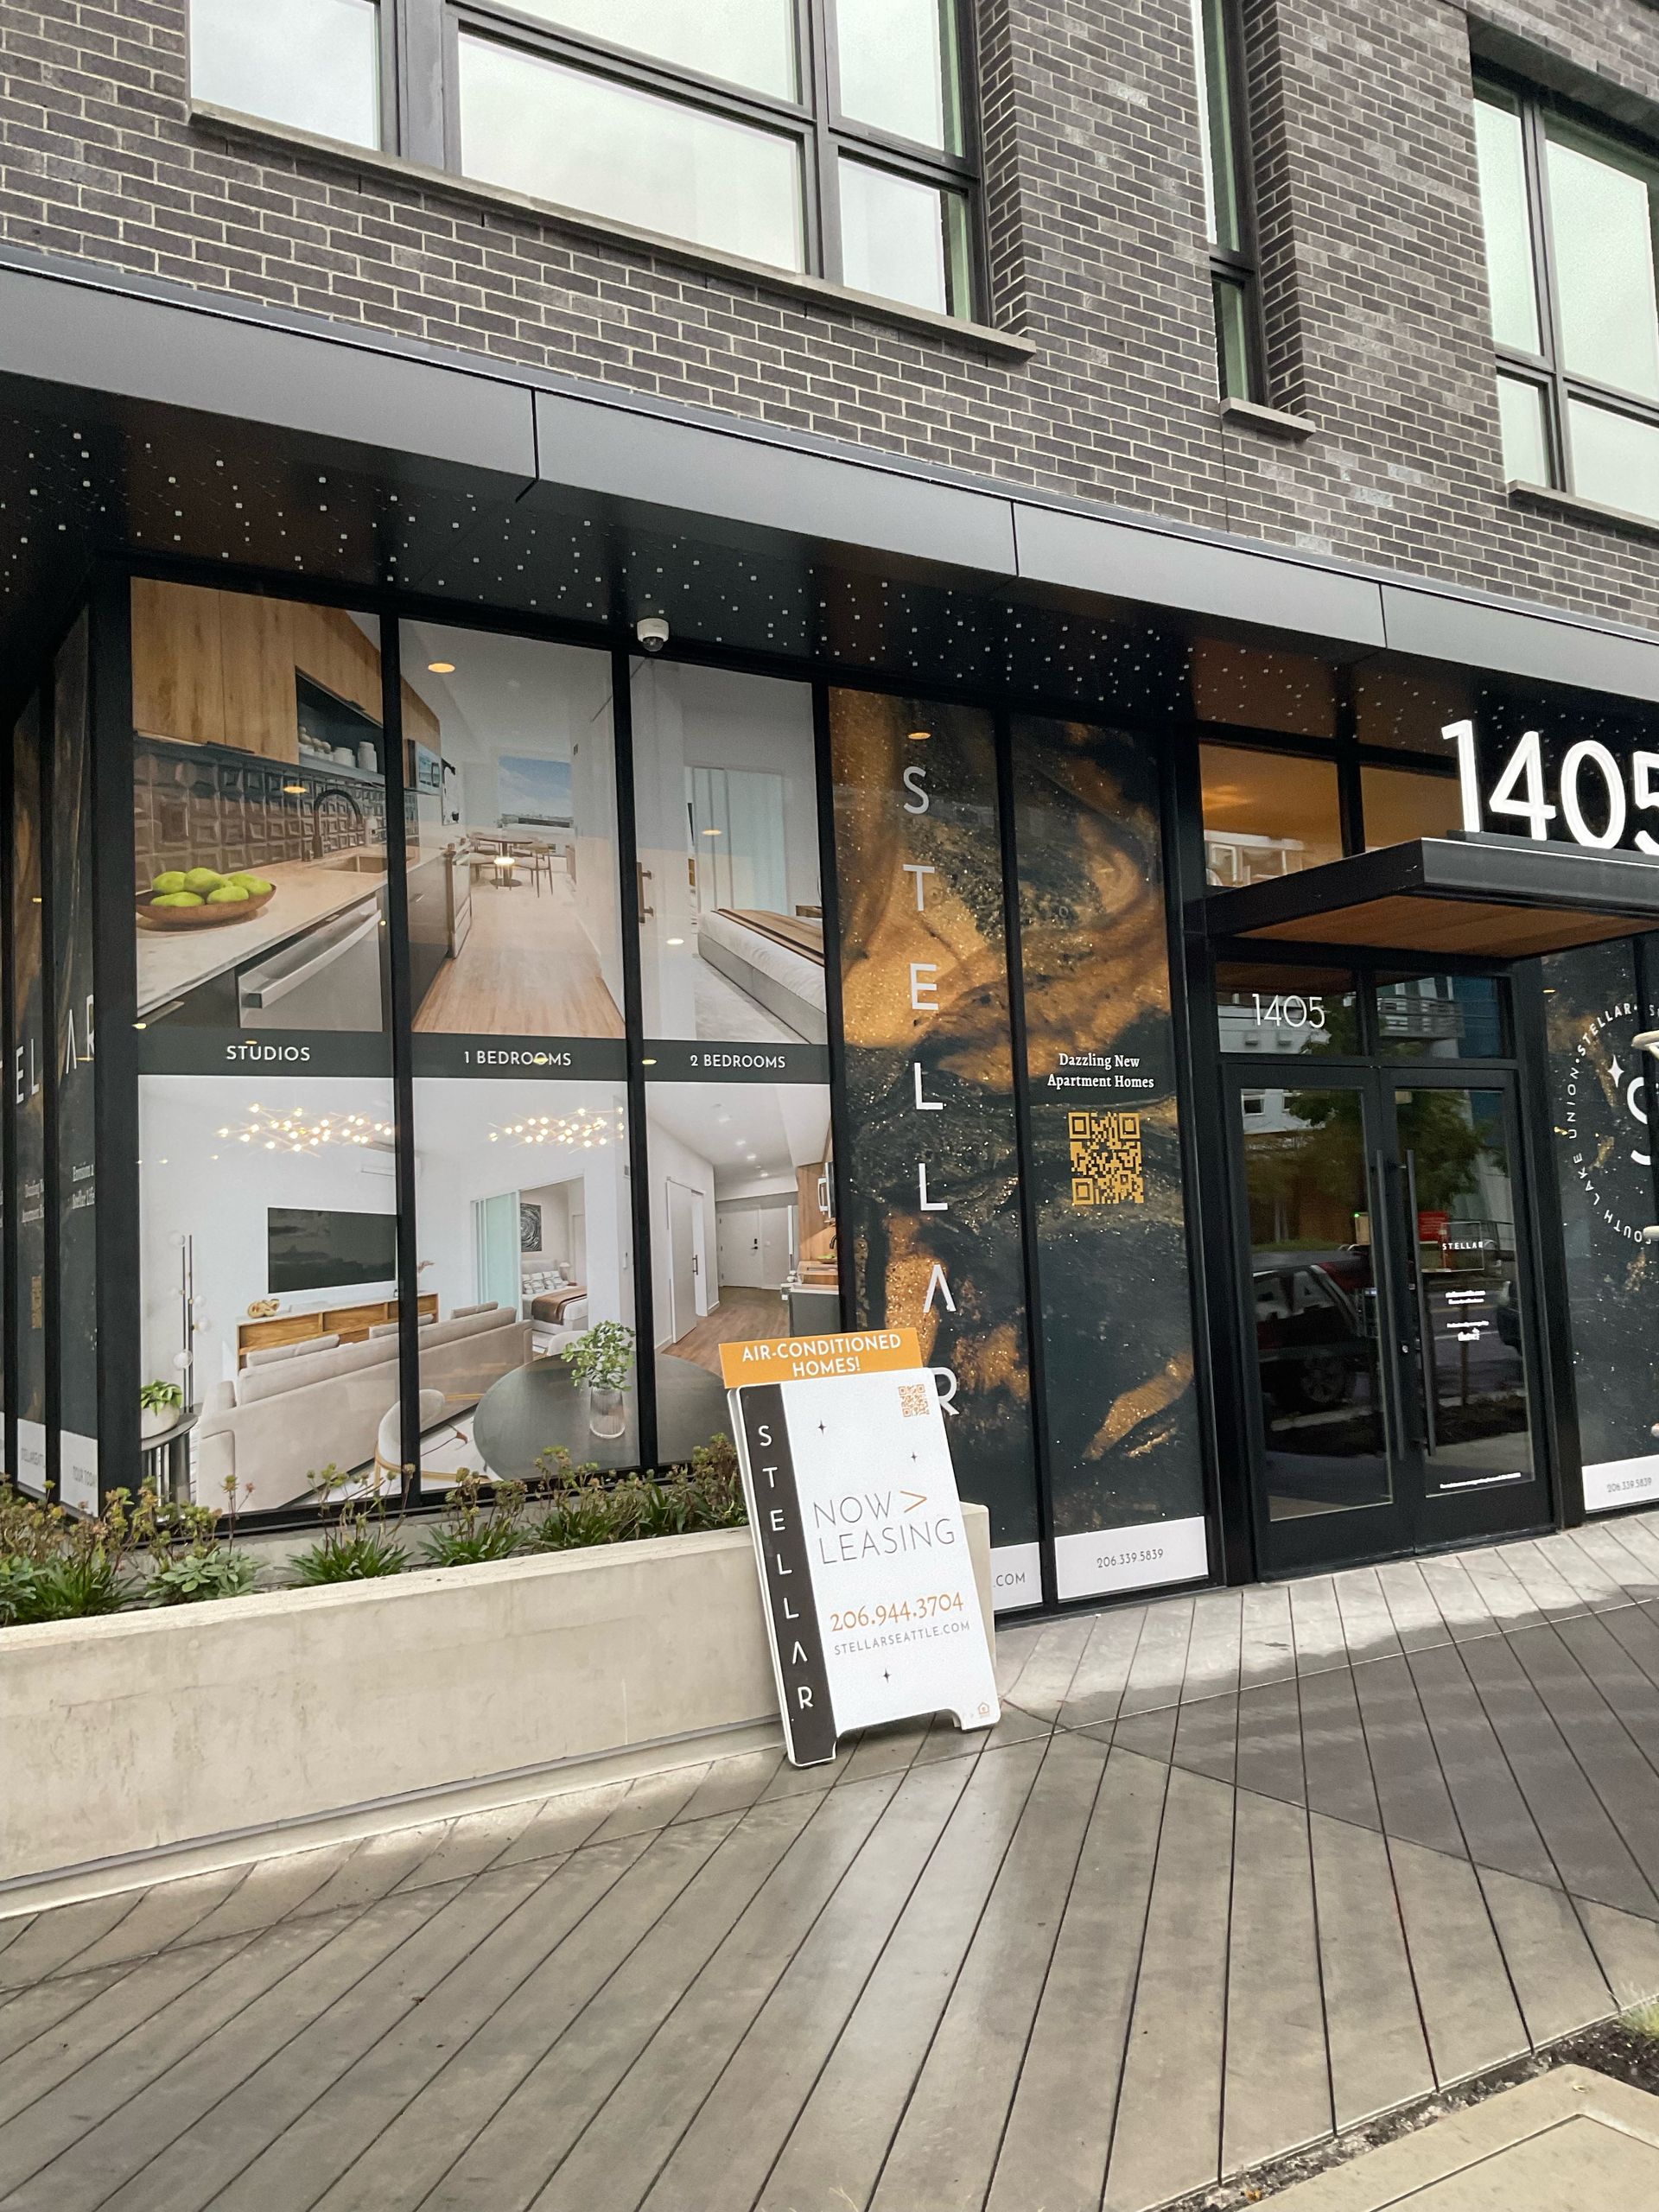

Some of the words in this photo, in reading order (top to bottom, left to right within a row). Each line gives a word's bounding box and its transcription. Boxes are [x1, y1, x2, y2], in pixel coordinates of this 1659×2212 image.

[1252, 994, 1325, 1028] 1405
[1577, 1002, 1631, 1057] STELLAR
[226, 1045, 311, 1062] STUDIOS
[464, 1050, 470, 1064] 1
[476, 1050, 572, 1066] BEDROOMS
[690, 1054, 699, 1067] 2
[703, 1054, 786, 1069] BEDROOMS
[1058, 1052, 1112, 1071] Dazzling
[1114, 1054, 1141, 1068] New
[903, 766, 960, 1415] STELLAR
[1047, 1073, 1112, 1090] Apartment
[1114, 1075, 1154, 1088] Homes
[1566, 1066, 1580, 1139] UNION
[1573, 1152, 1600, 1206] LAKE
[1442, 1241, 1484, 1250] STELLAR
[741, 1333, 901, 1363] AIR-CONDITIONED
[791, 1356, 861, 1377] HOMES!
[813, 1491, 892, 1529] NOW
[819, 1518, 956, 1565] LEASING
[1096, 1548, 1164, 1568] 206.339.5839
[757, 1425, 814, 1710] STELLAR
[830, 1591, 965, 1632] 206.944.3704
[834, 1619, 970, 1656] STELLARSEATTLE.COM
